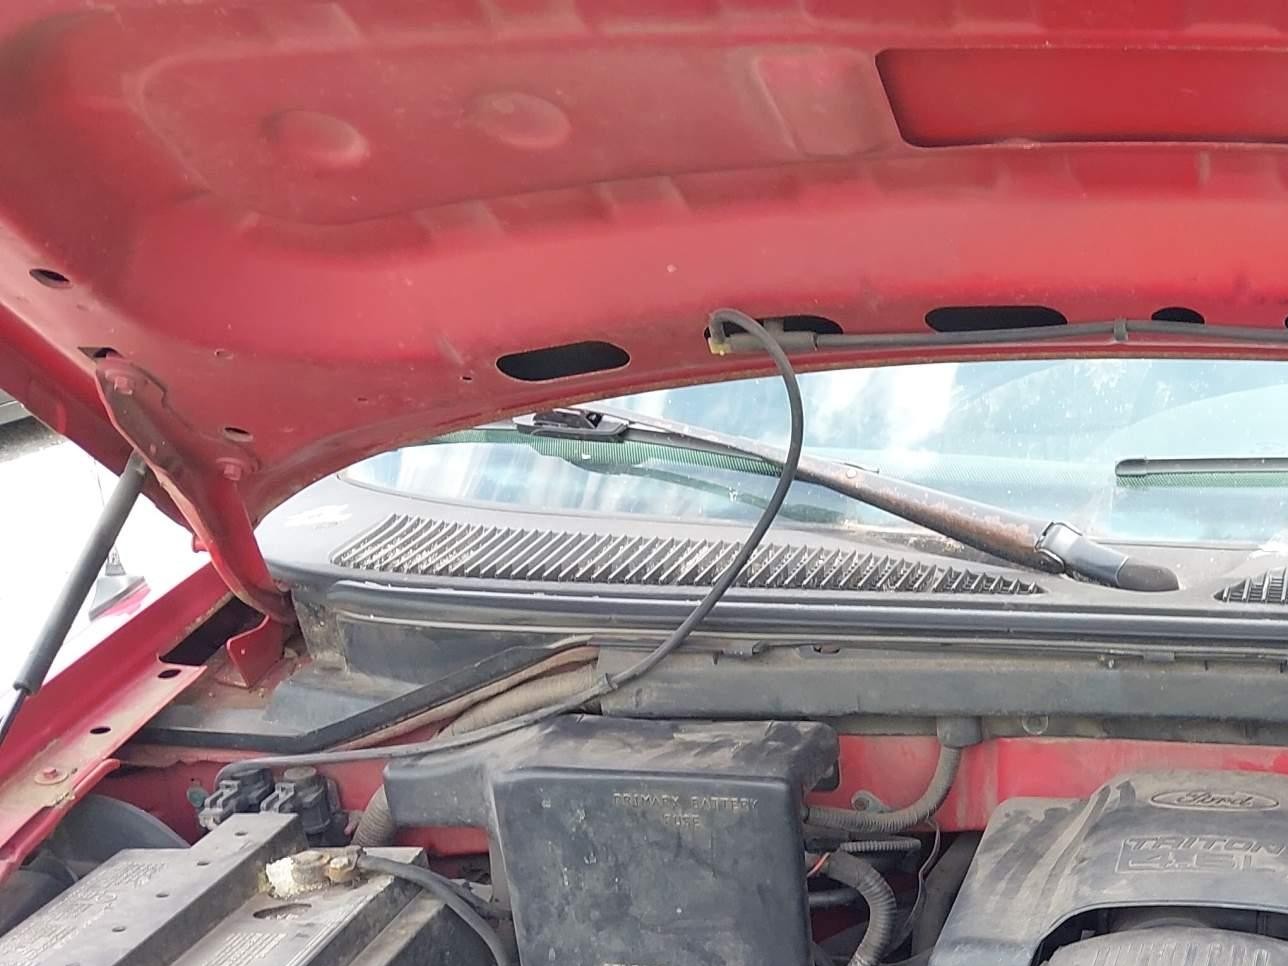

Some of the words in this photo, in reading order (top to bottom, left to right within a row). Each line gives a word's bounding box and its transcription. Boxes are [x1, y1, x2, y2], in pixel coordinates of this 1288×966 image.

[613, 793, 680, 809] PRIMARY
[691, 796, 758, 811] BATTERY
[1176, 791, 1253, 806] Ford
[663, 813, 700, 827] FUSE
[1127, 835, 1288, 857] TRITON
